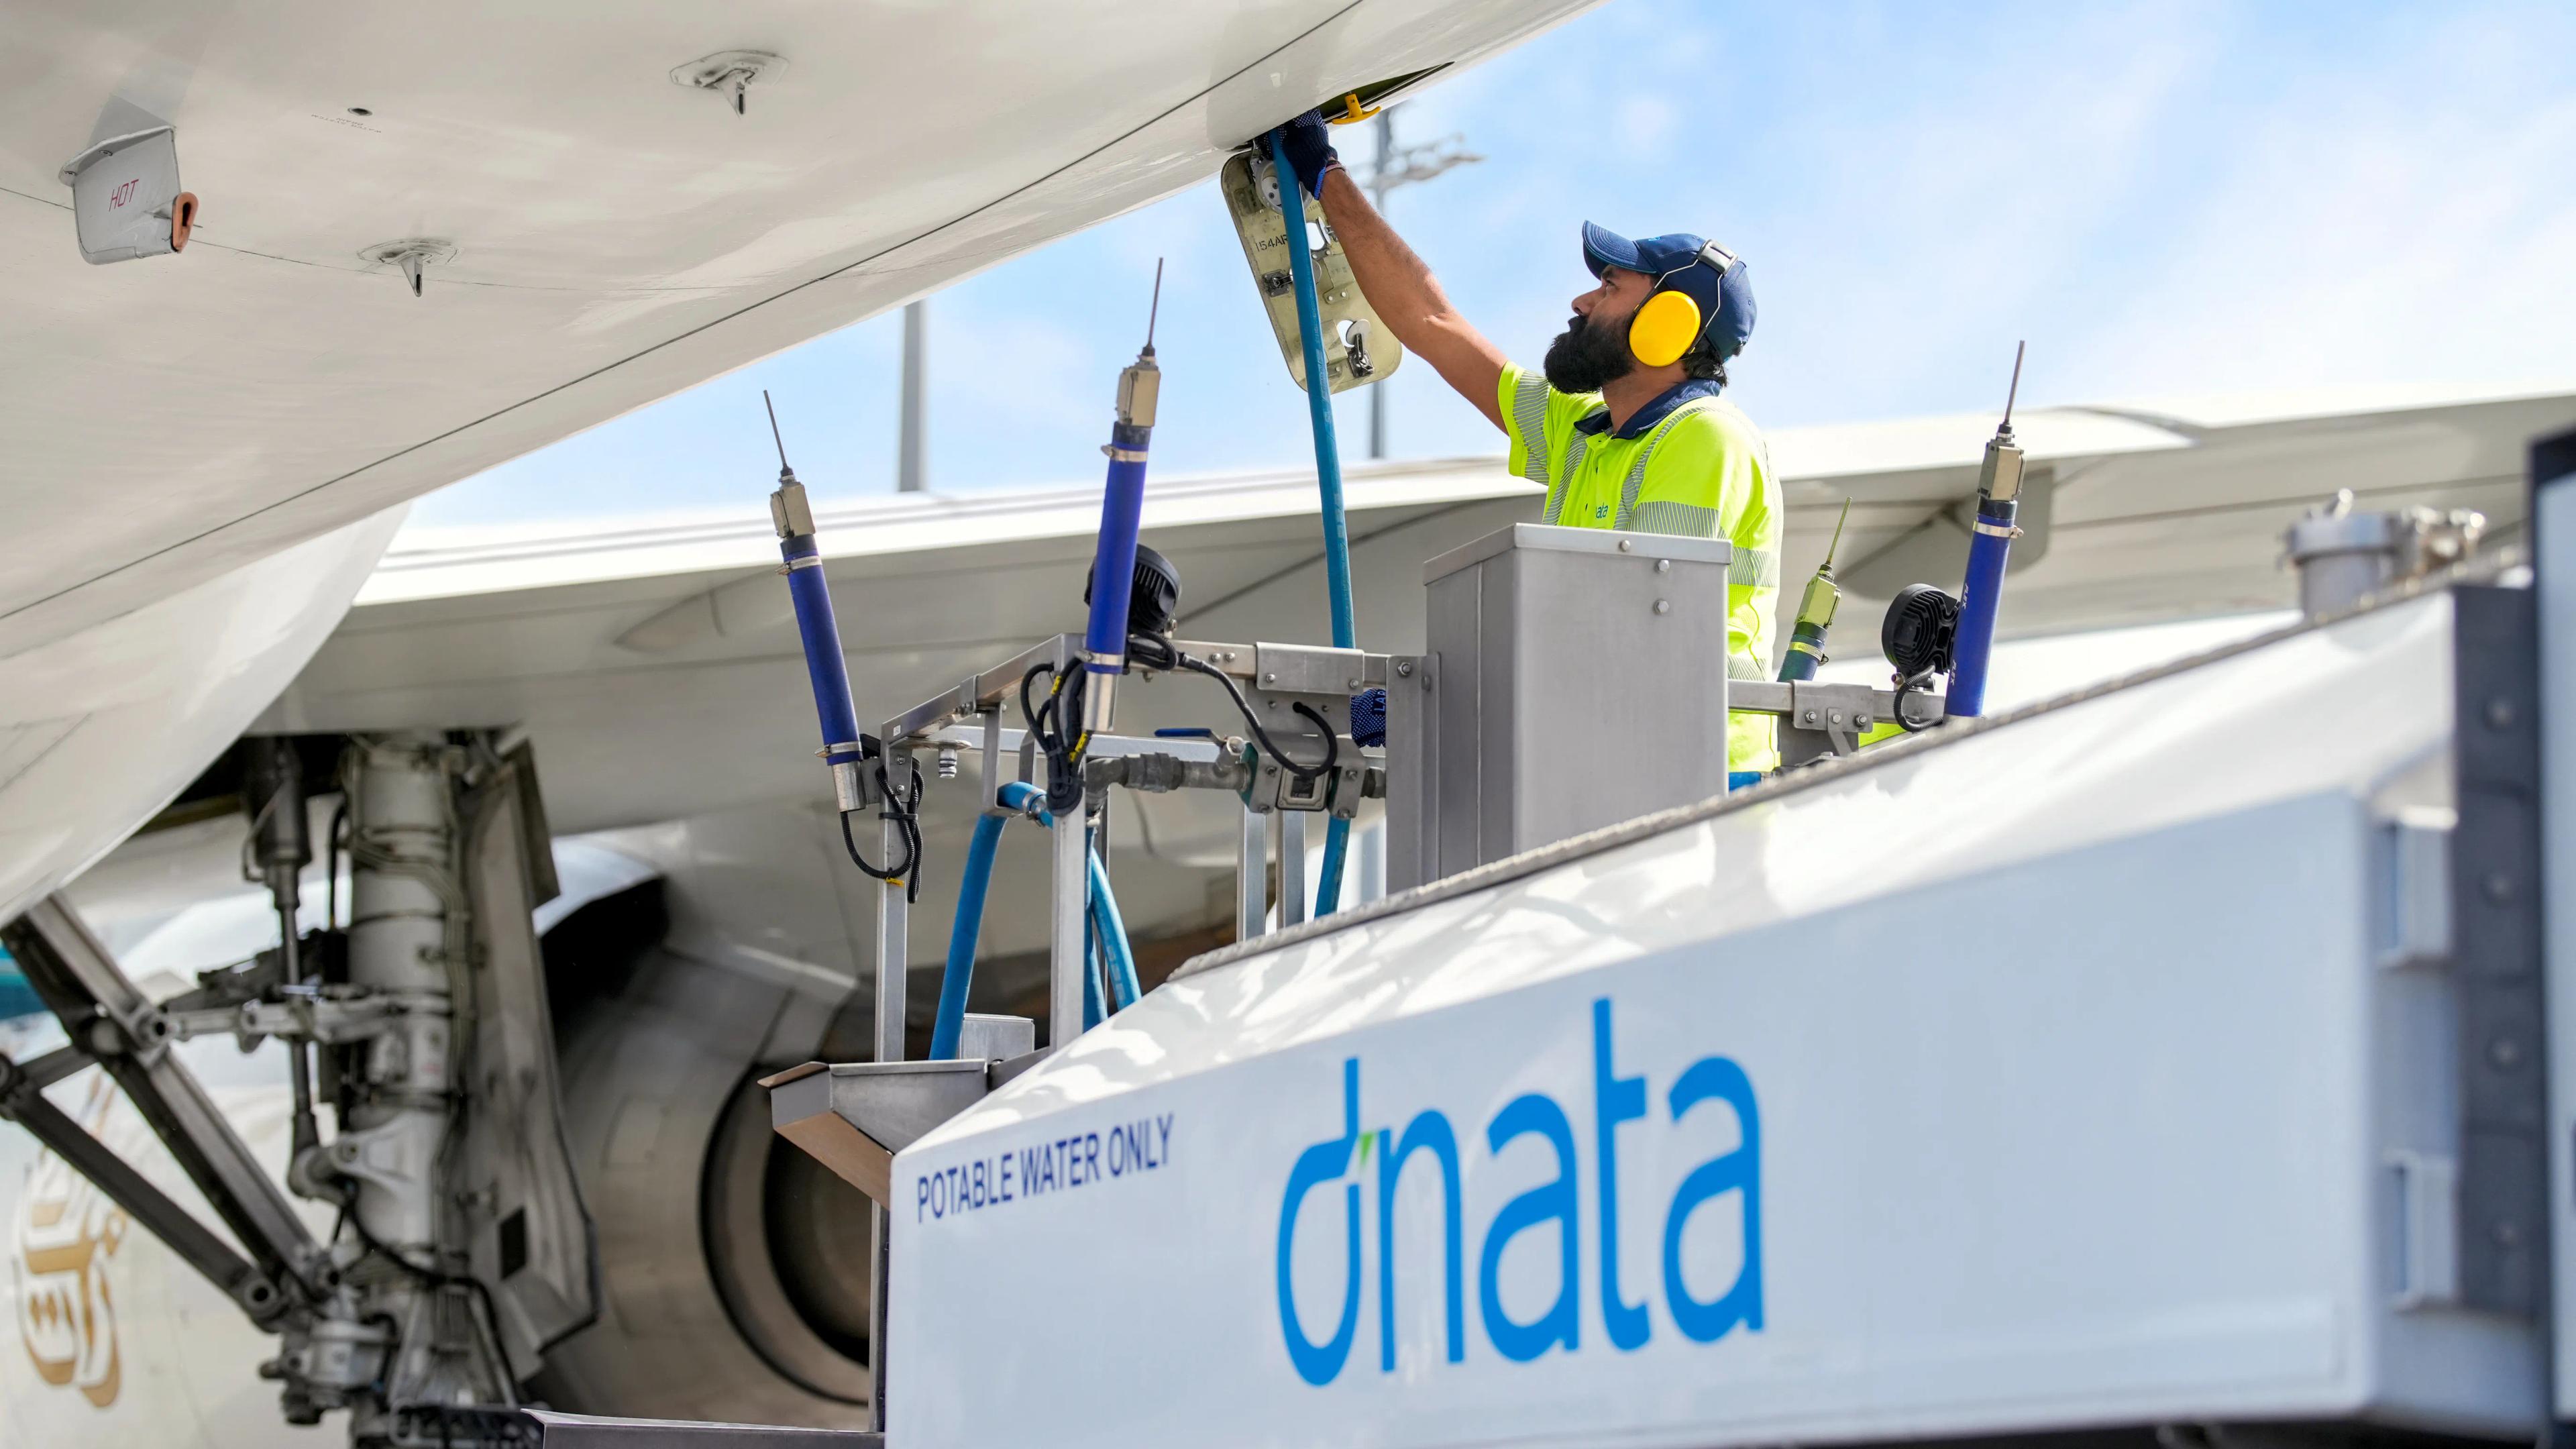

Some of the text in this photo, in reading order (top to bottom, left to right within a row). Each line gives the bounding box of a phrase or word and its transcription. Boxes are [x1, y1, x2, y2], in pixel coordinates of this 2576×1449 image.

[109, 178, 139, 212] HOT
[918, 1112, 1174, 1224] POTABLE WATER ONLY
[1277, 997, 1764, 1387] dnata
